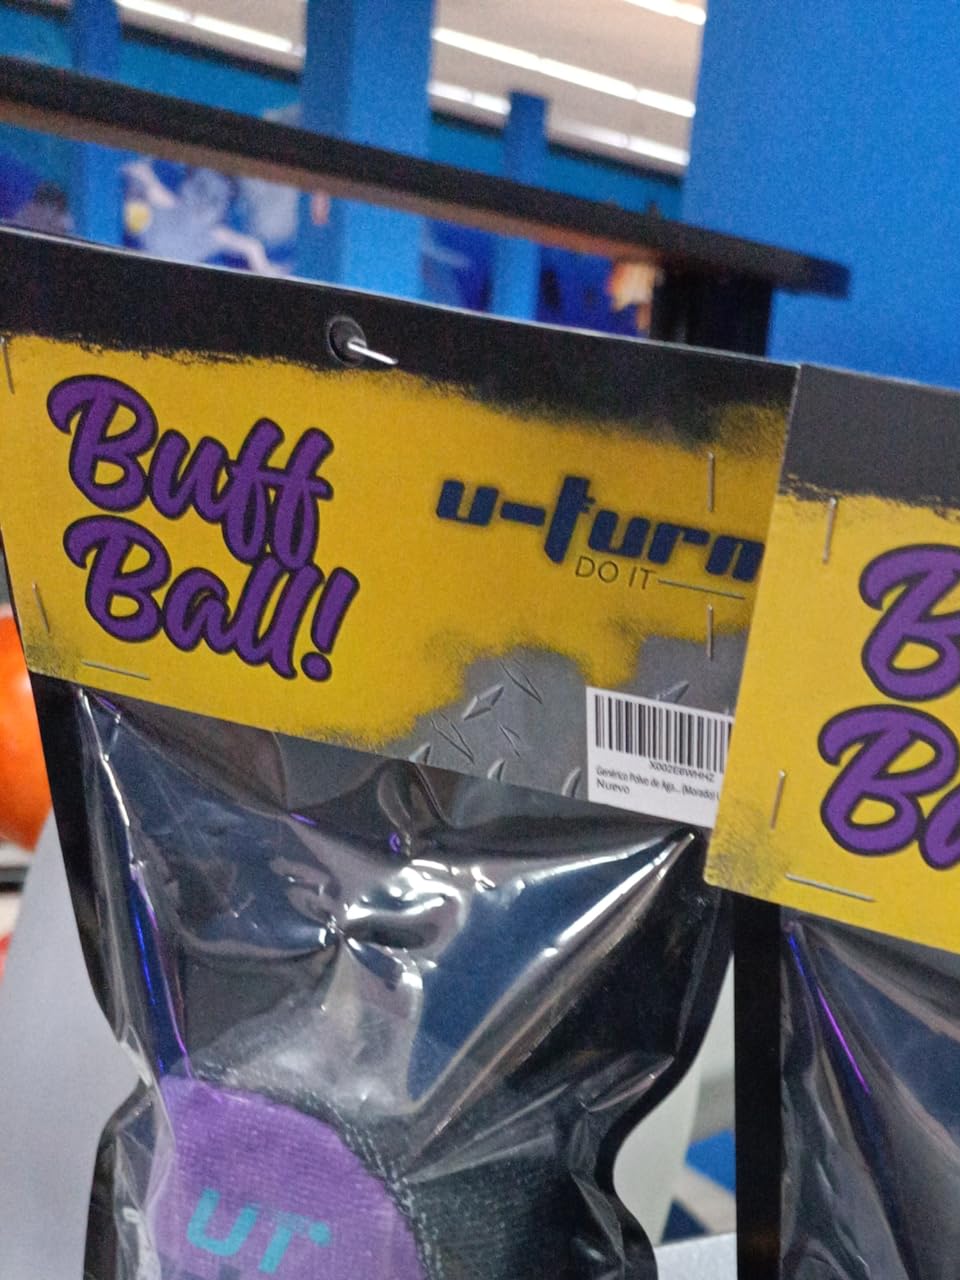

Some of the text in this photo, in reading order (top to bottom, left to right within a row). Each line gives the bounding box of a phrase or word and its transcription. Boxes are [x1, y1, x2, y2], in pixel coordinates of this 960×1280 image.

[47, 374, 334, 567] Buff
[435, 474, 766, 584] u-turn
[574, 556, 657, 591] DO IT
[63, 514, 361, 681] Ball!
[597, 778, 630, 794] Nuevo
